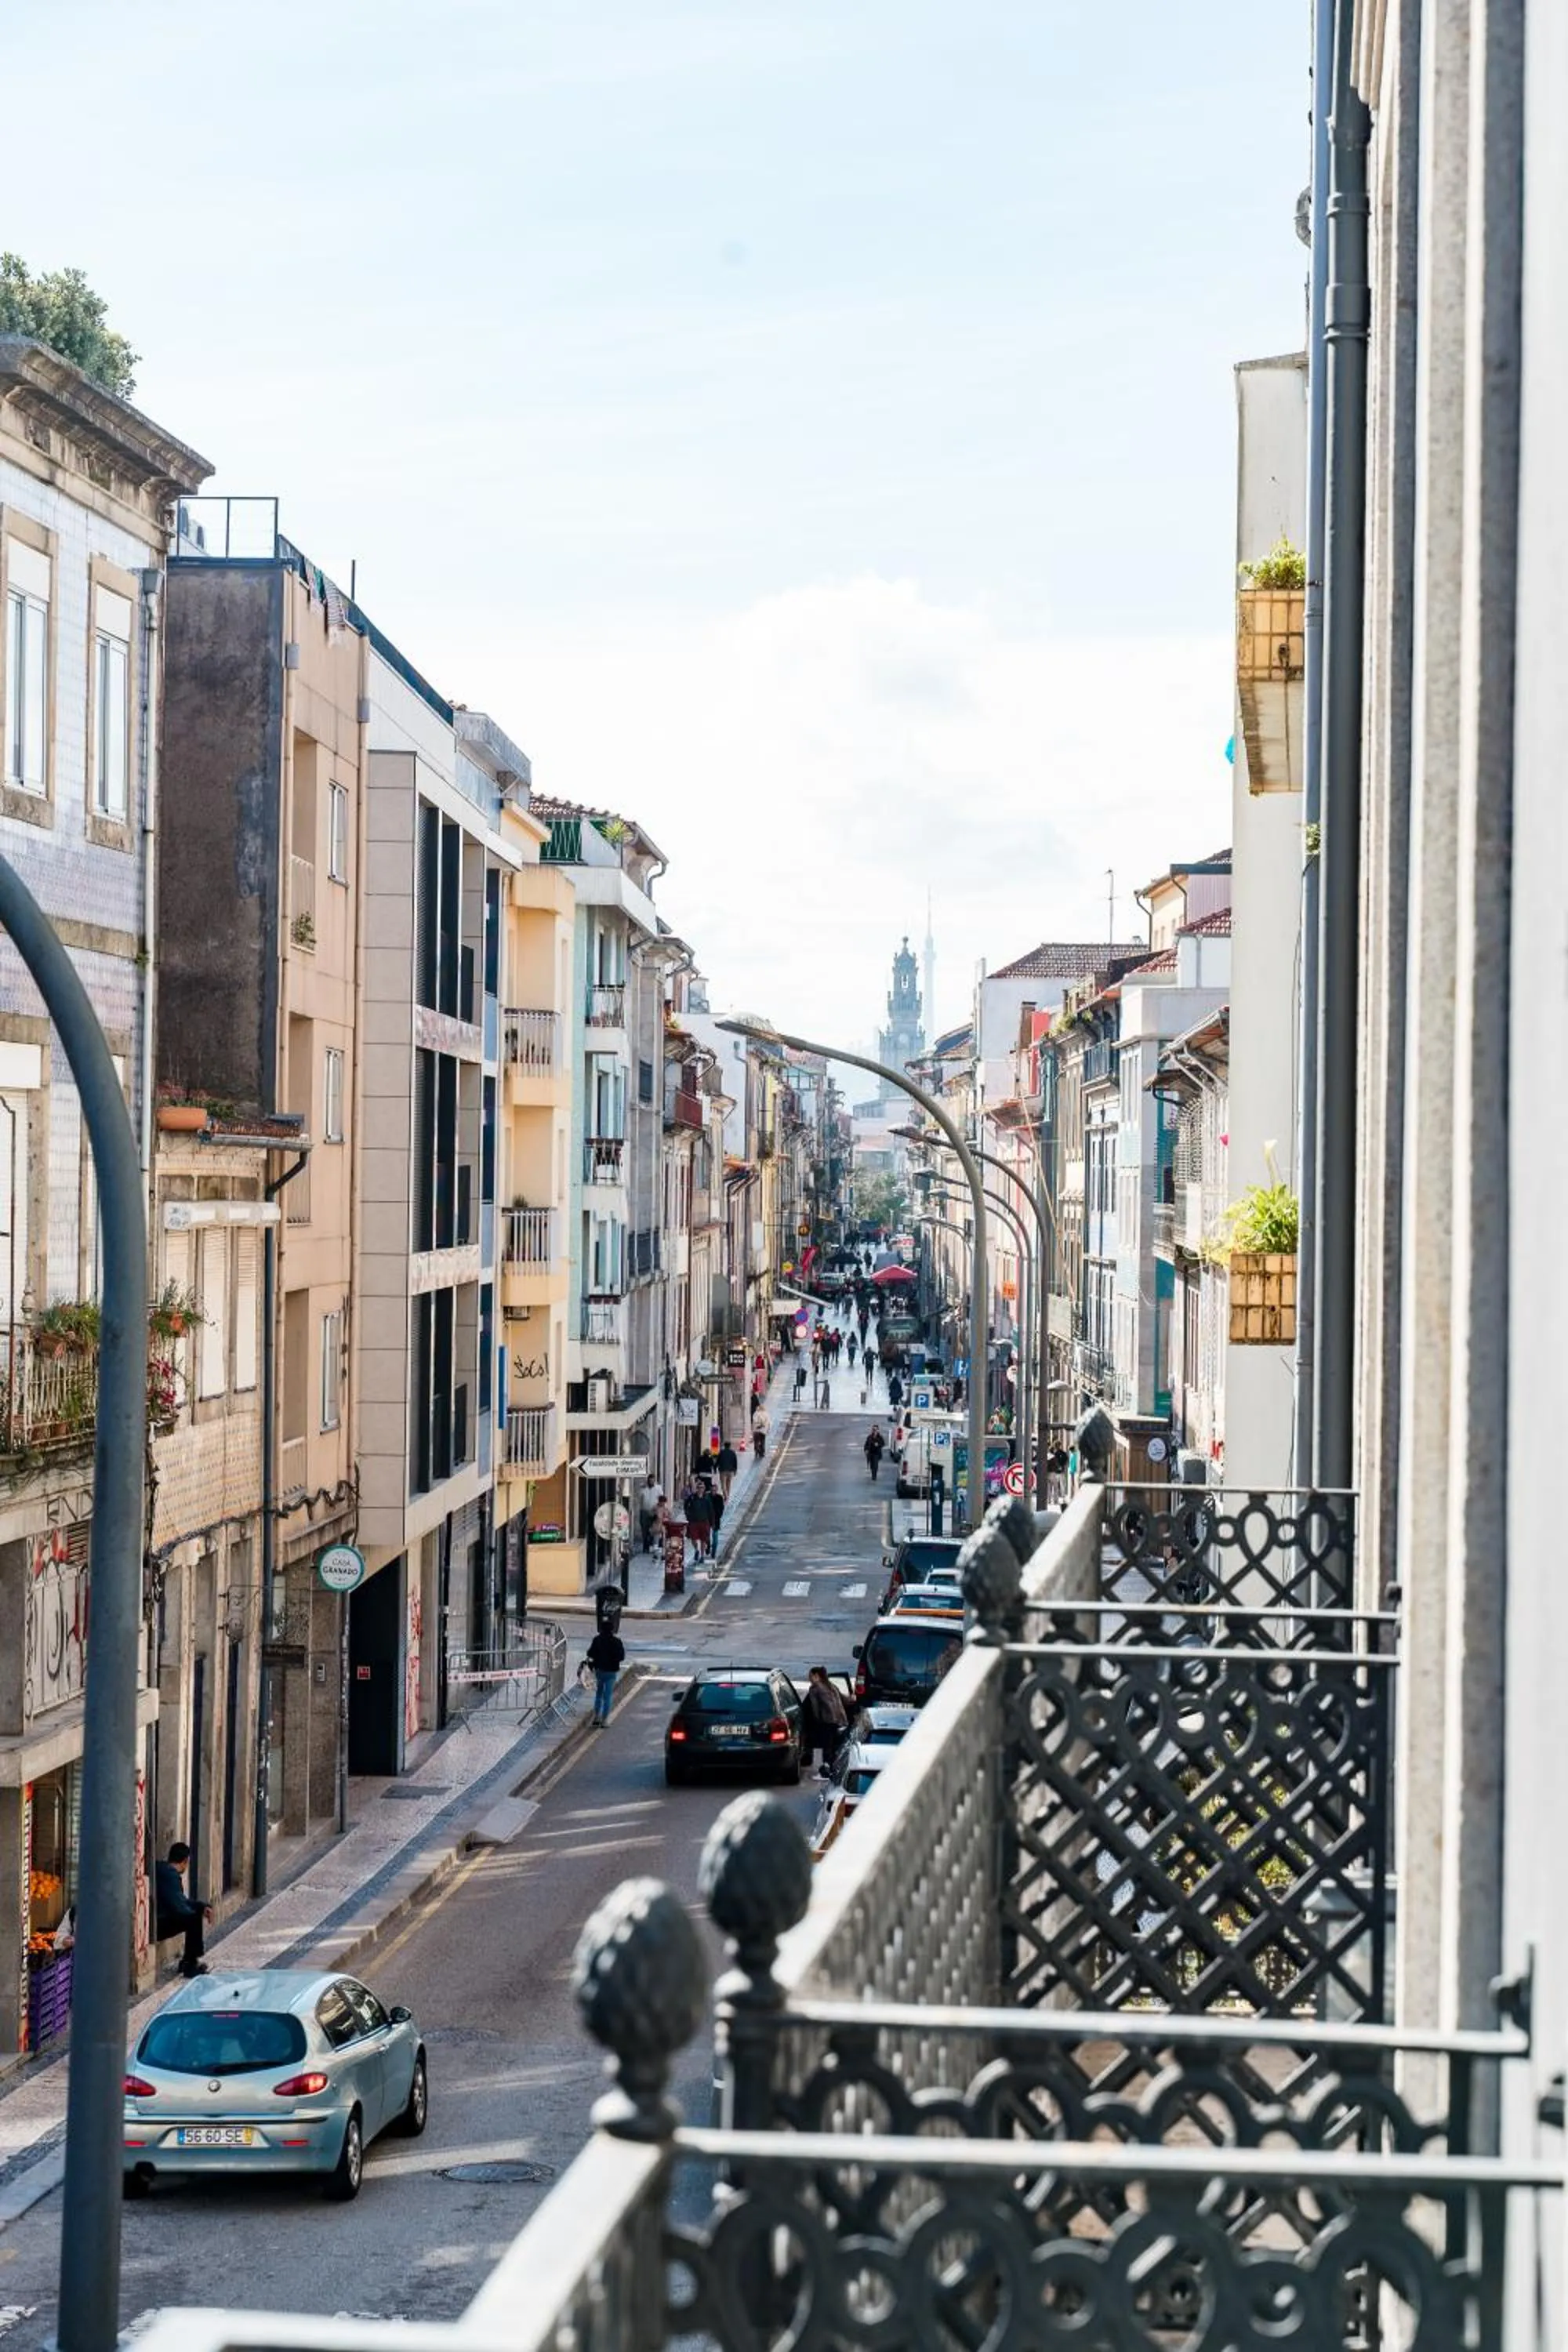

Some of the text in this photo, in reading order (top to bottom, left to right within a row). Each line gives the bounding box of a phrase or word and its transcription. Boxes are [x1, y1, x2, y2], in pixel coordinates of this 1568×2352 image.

[918, 1396, 926, 1406] P
[322, 1566, 358, 1575] GRANADO
[186, 2129, 201, 2143] 56
[225, 2129, 243, 2143] SE
